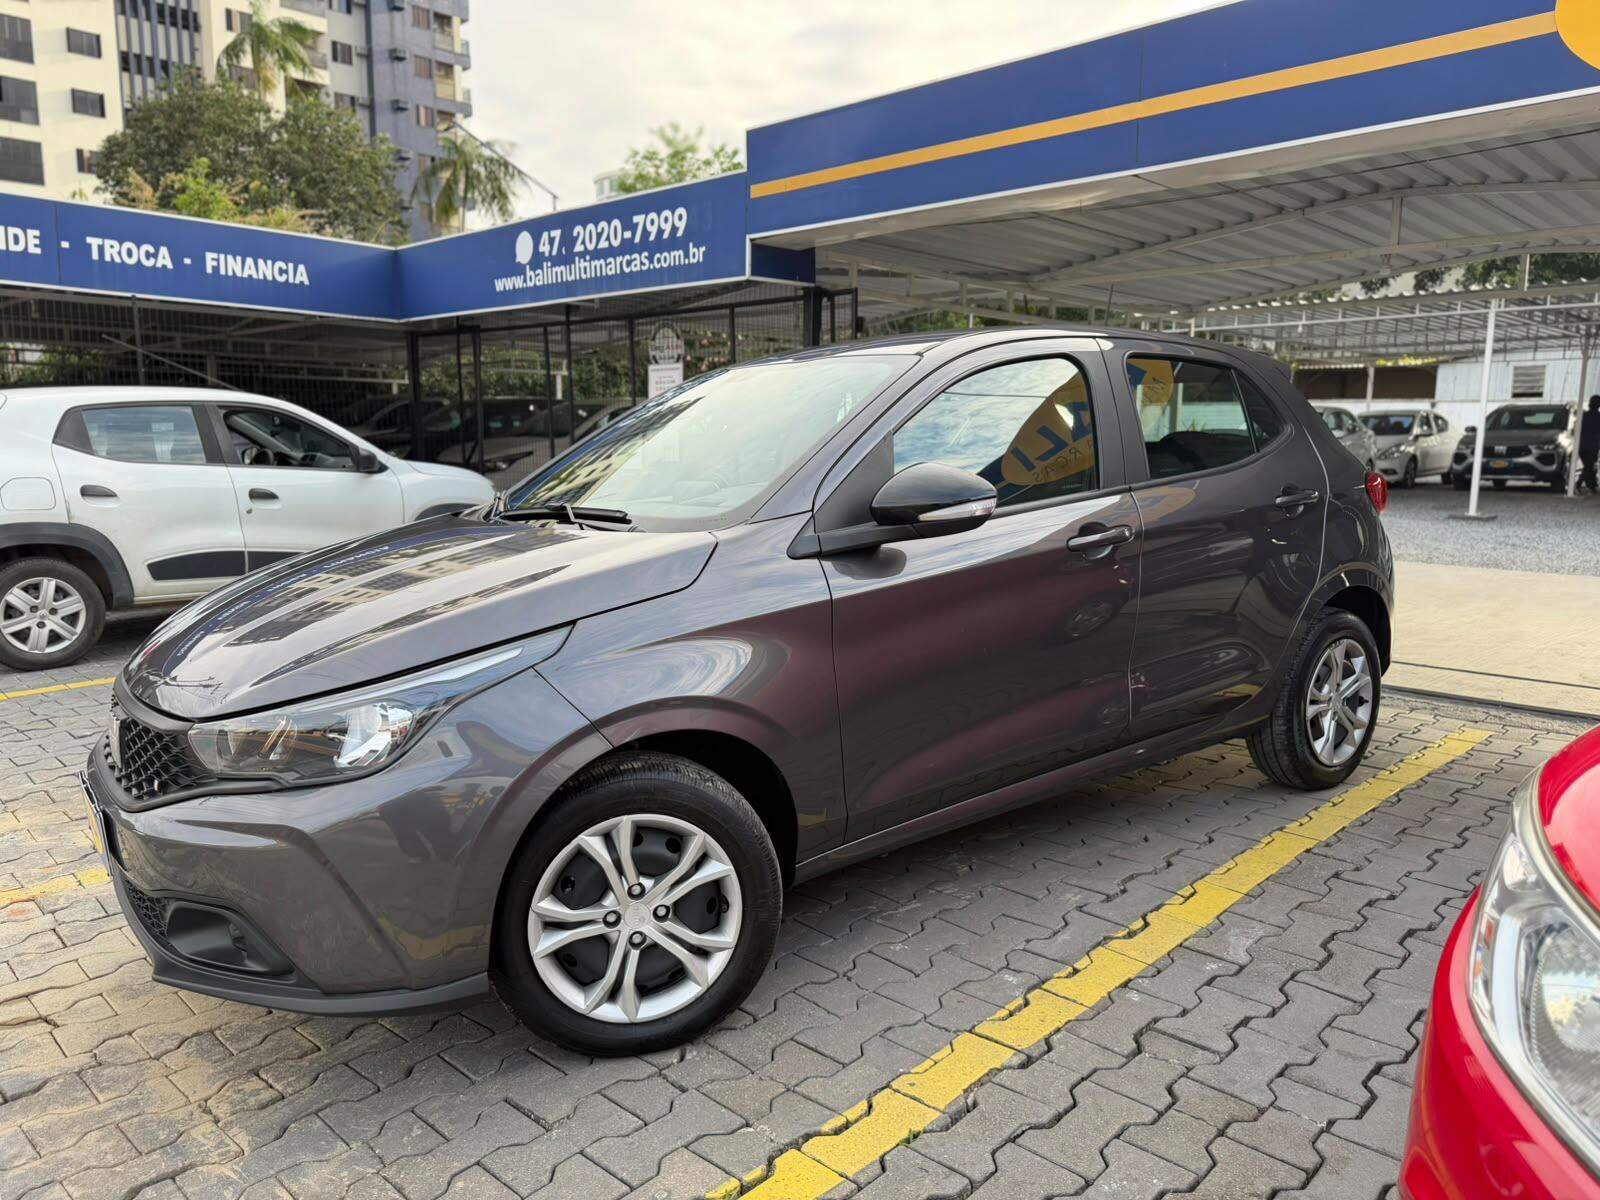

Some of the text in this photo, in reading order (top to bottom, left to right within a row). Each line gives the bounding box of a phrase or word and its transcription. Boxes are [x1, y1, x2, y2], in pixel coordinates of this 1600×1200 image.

[572, 206, 688, 253] 2020-7999
[86, 236, 174, 270] TROCA
[205, 252, 310, 285] FINANCIA
[494, 242, 706, 292] www.balimultimarcas.com.br
